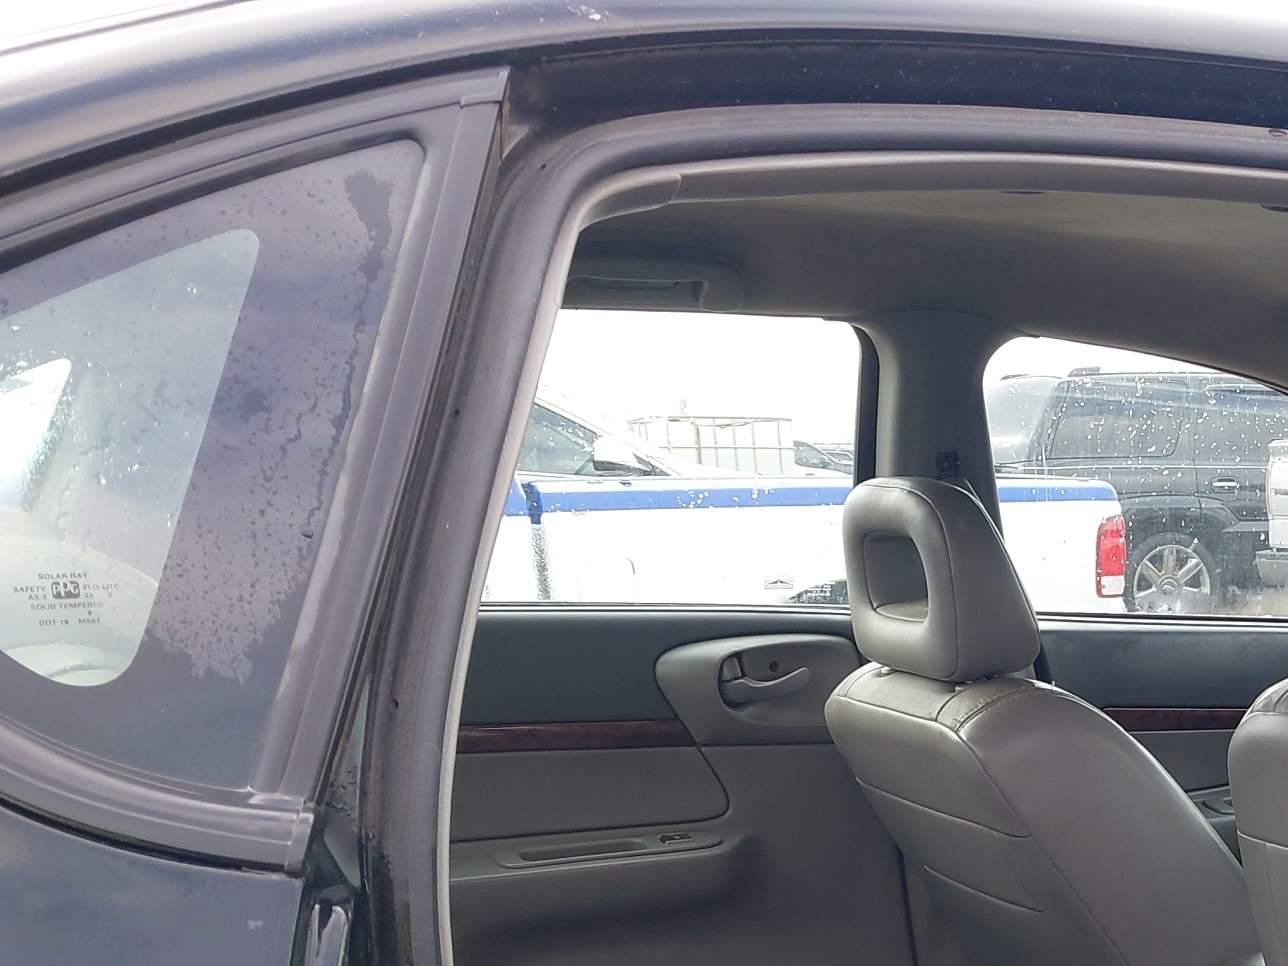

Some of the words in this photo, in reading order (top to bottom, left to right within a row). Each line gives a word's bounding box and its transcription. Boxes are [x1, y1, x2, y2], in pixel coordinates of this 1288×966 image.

[38, 572, 67, 580] SOLAR
[13, 585, 46, 593] SAFETY
[51, 580, 81, 599] PPG
[30, 603, 56, 611] SOLID
[60, 601, 104, 610] TEMPERED
